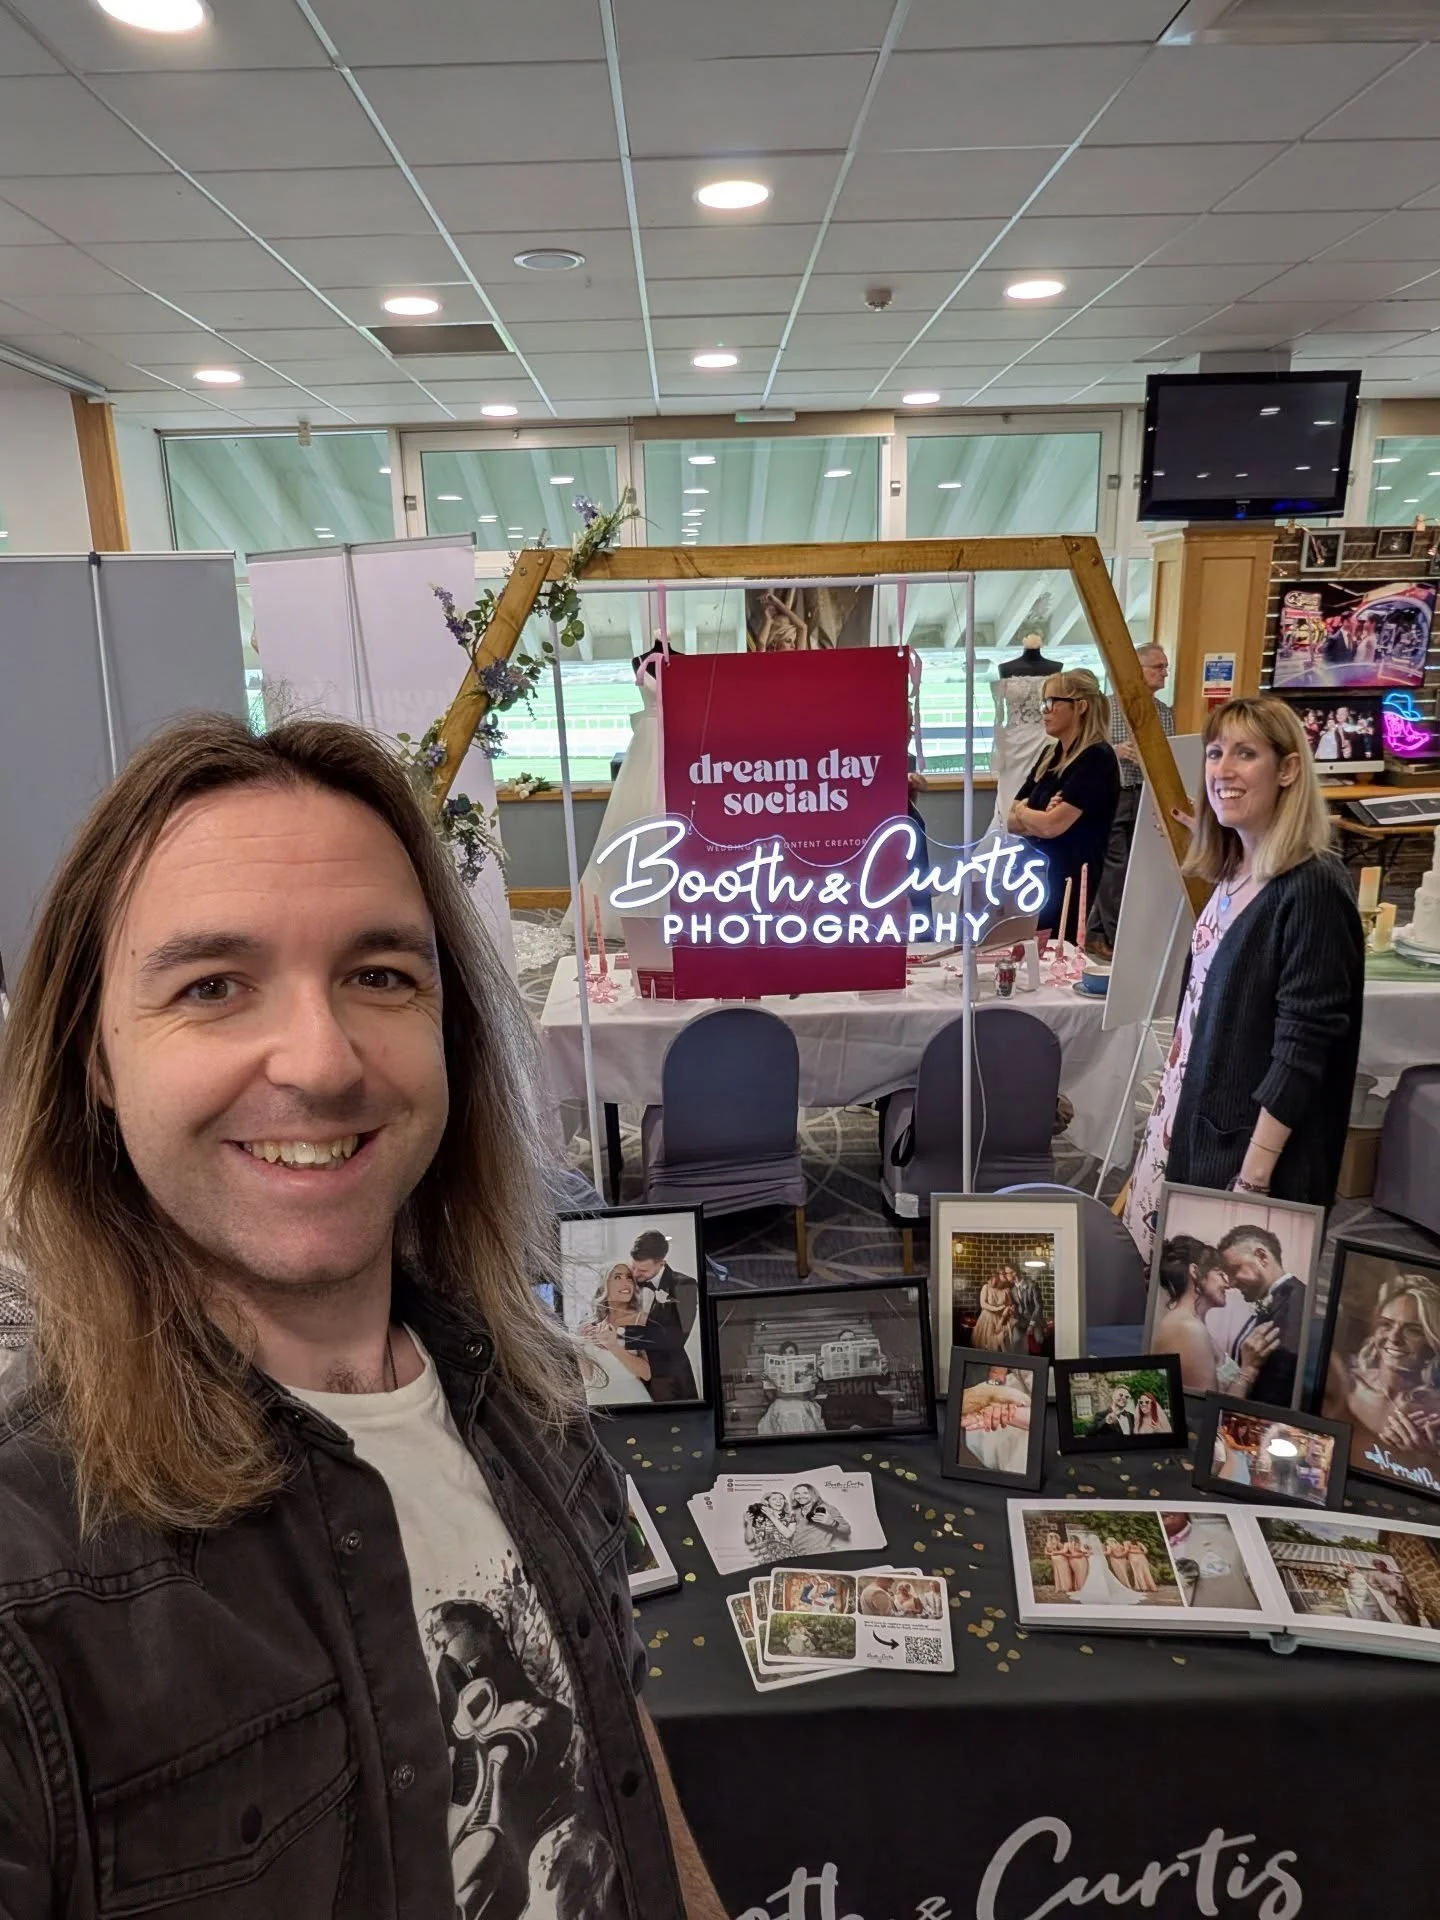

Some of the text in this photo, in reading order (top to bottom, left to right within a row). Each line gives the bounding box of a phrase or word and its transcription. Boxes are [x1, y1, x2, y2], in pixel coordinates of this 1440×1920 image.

[689, 748, 881, 787] dream day
[723, 782, 849, 816] socials
[782, 840, 821, 849] ONTENT
[597, 820, 1046, 914] Booth & Curtis
[663, 912, 989, 945] PHOTOGRAPHY
[976, 1816, 1302, 1920] Curtis
